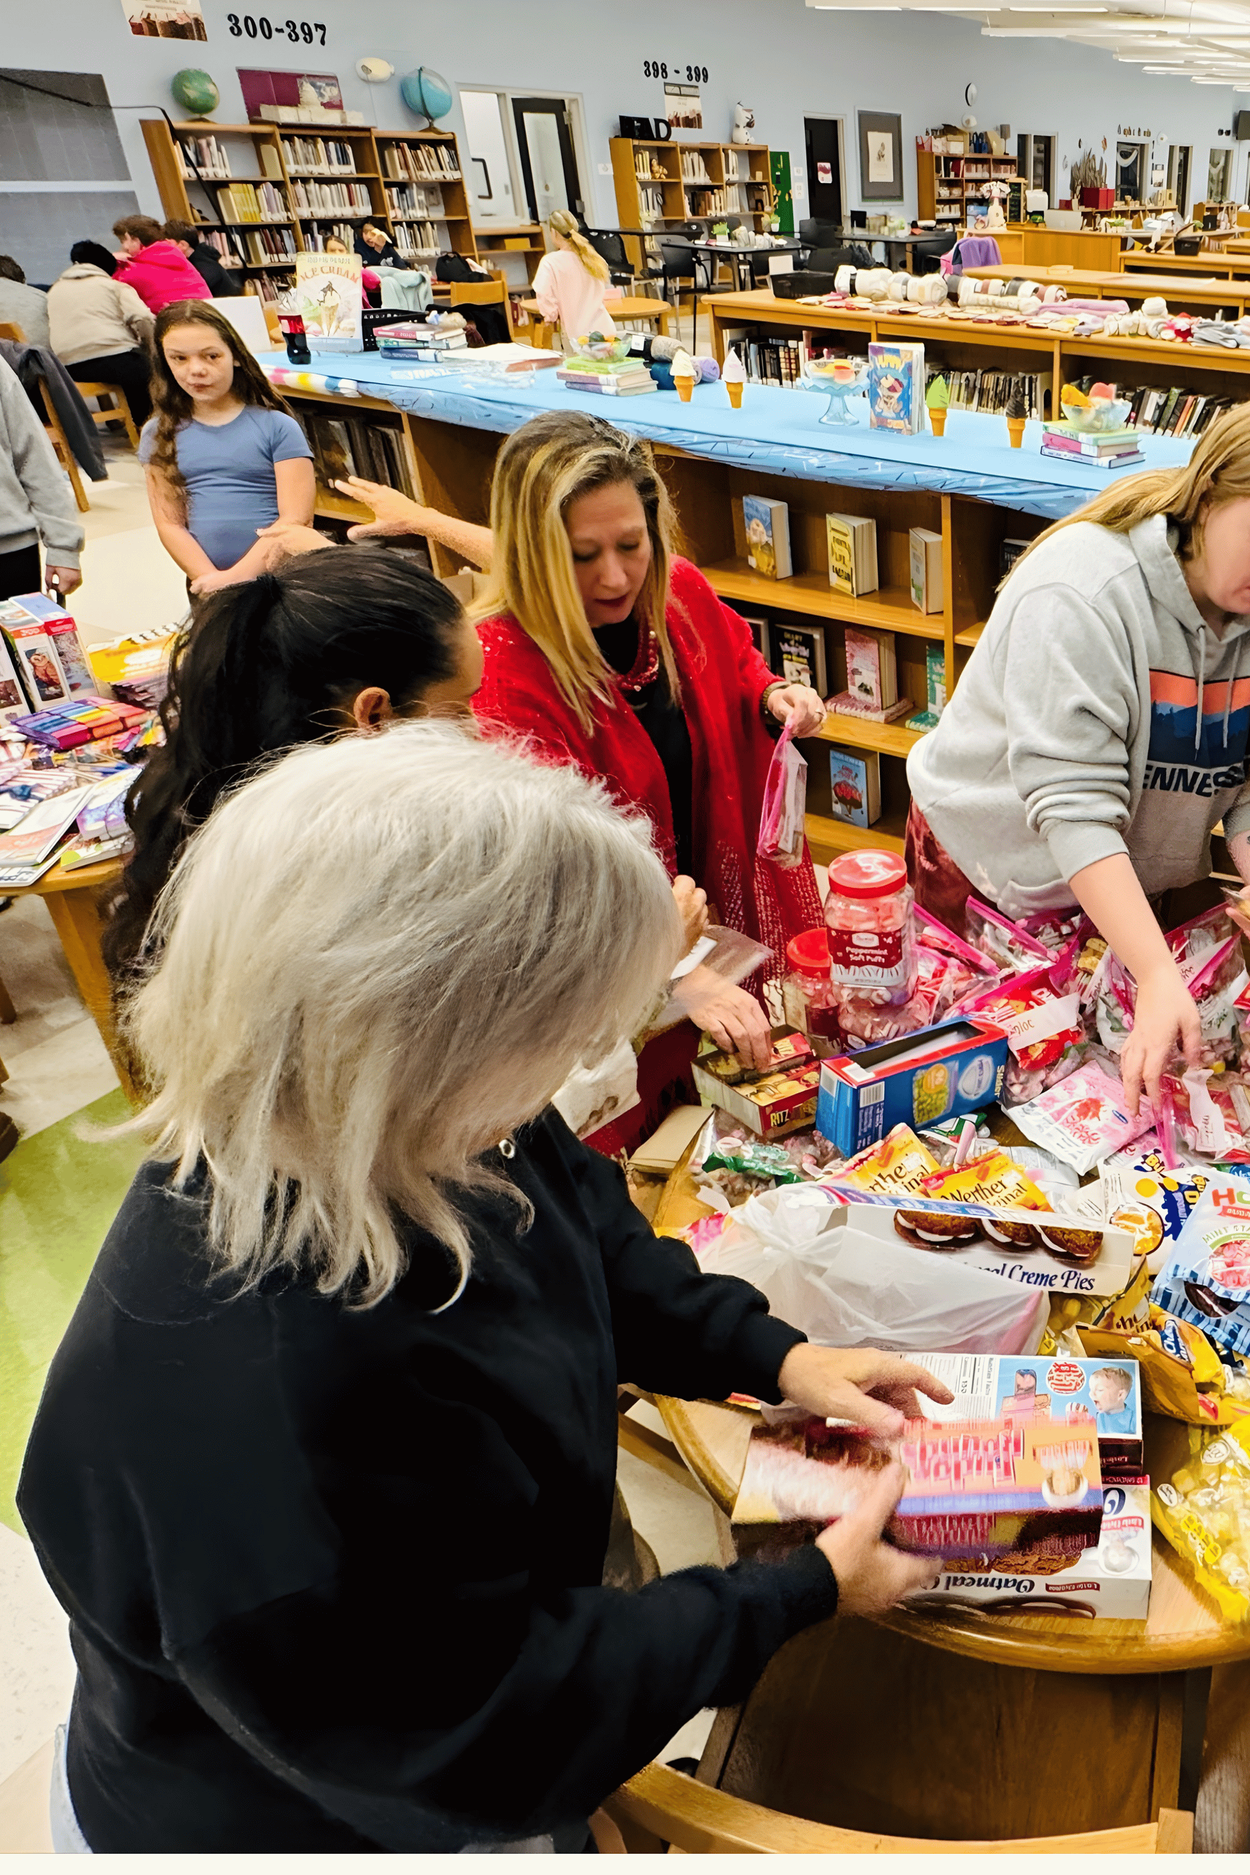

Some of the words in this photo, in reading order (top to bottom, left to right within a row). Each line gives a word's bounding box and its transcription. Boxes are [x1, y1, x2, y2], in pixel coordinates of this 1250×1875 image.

[227, 13, 327, 47] 300-397
[643, 60, 669, 80] 398
[685, 65, 709, 83] 399
[1142, 763, 1246, 798] ENNES
[770, 1109, 790, 1128] RITZ
[1202, 1226, 1229, 1244] MINT
[1007, 1264, 1059, 1288] Creme
[1060, 1269, 1096, 1291] Pies
[943, 1575, 1036, 1594] Oatmeal
